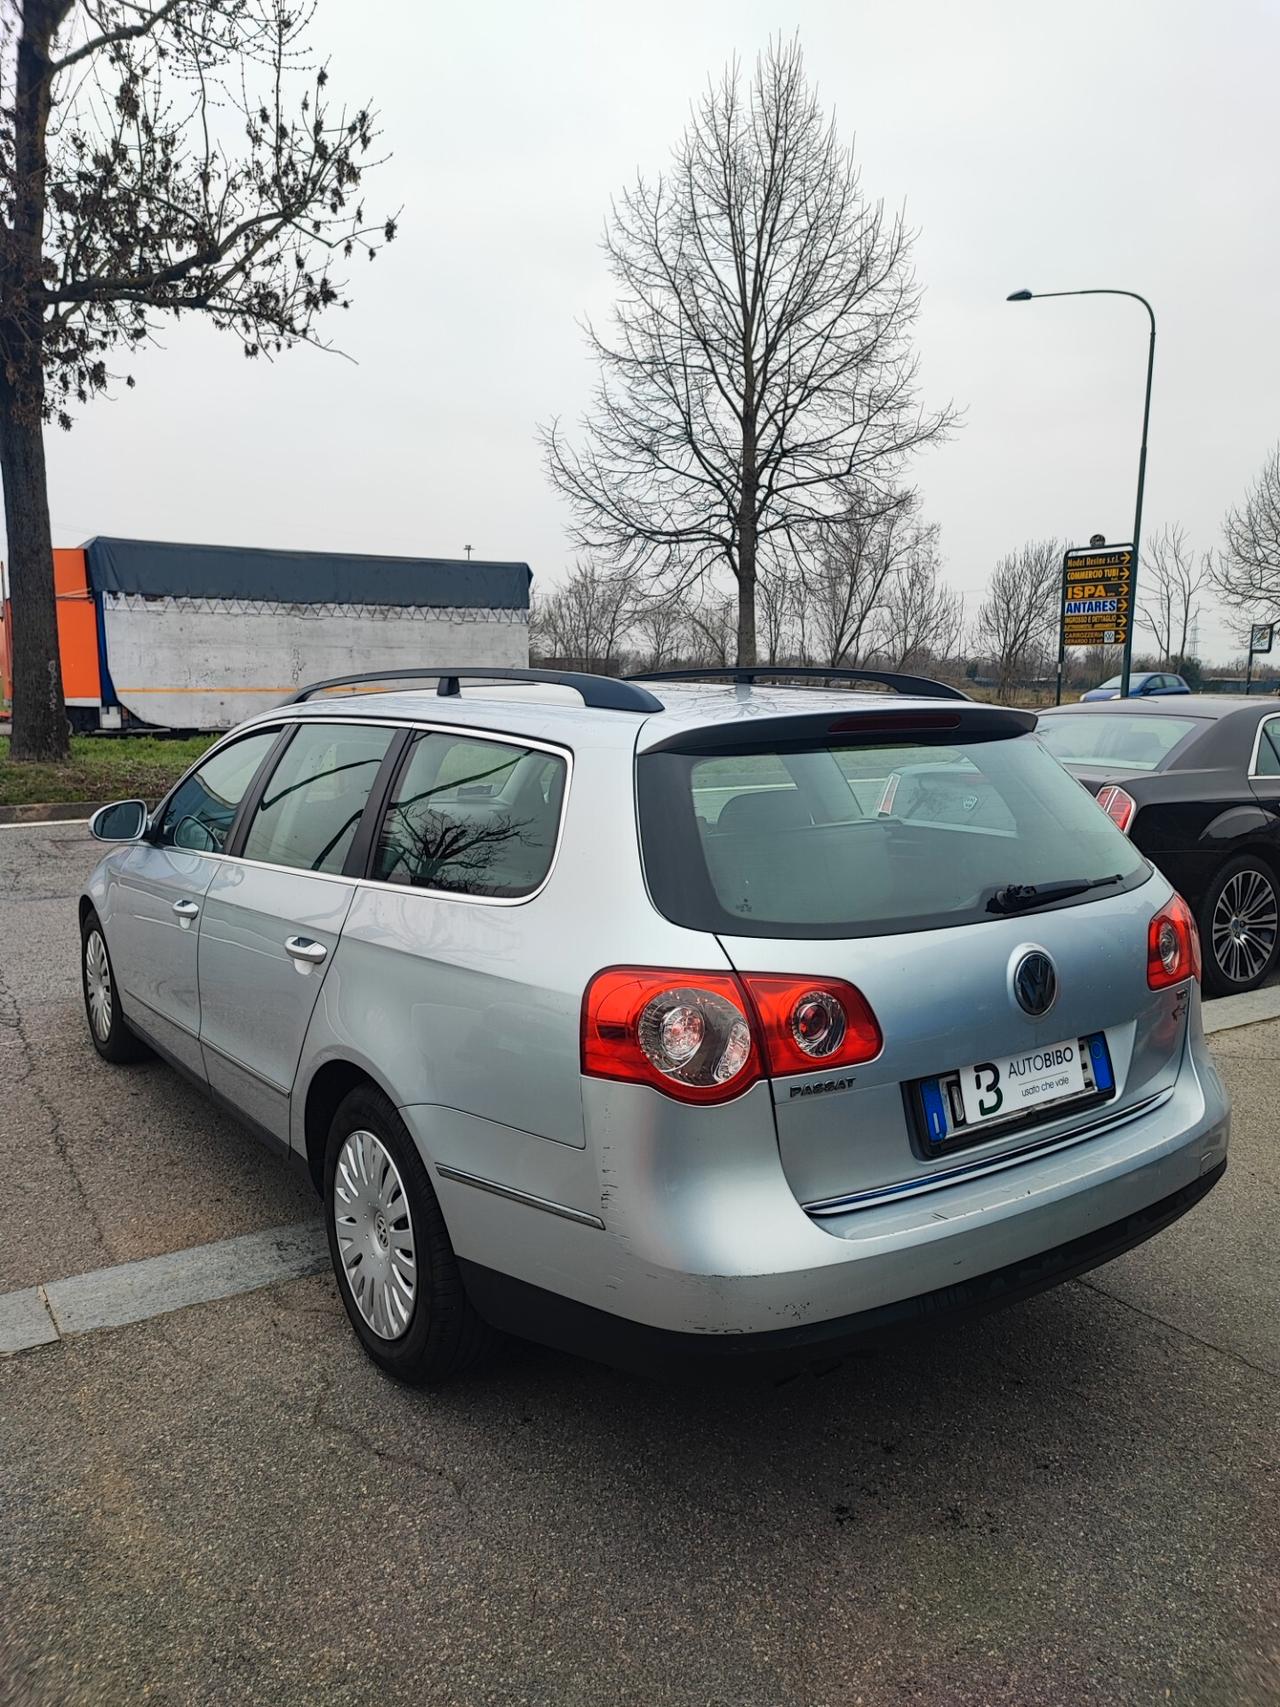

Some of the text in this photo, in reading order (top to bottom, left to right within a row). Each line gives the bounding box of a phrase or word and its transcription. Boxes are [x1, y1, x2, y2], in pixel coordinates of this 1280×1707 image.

[1067, 570, 1103, 580] COMMERCIO
[1104, 568, 1119, 577] TUBI
[1068, 585, 1106, 599] ISPA
[1066, 600, 1116, 613] ANTARES
[1008, 1046, 1074, 1078] AUTOBIBO
[789, 1076, 856, 1098] PASSAT
[1021, 1076, 1070, 1097] usato che vale
